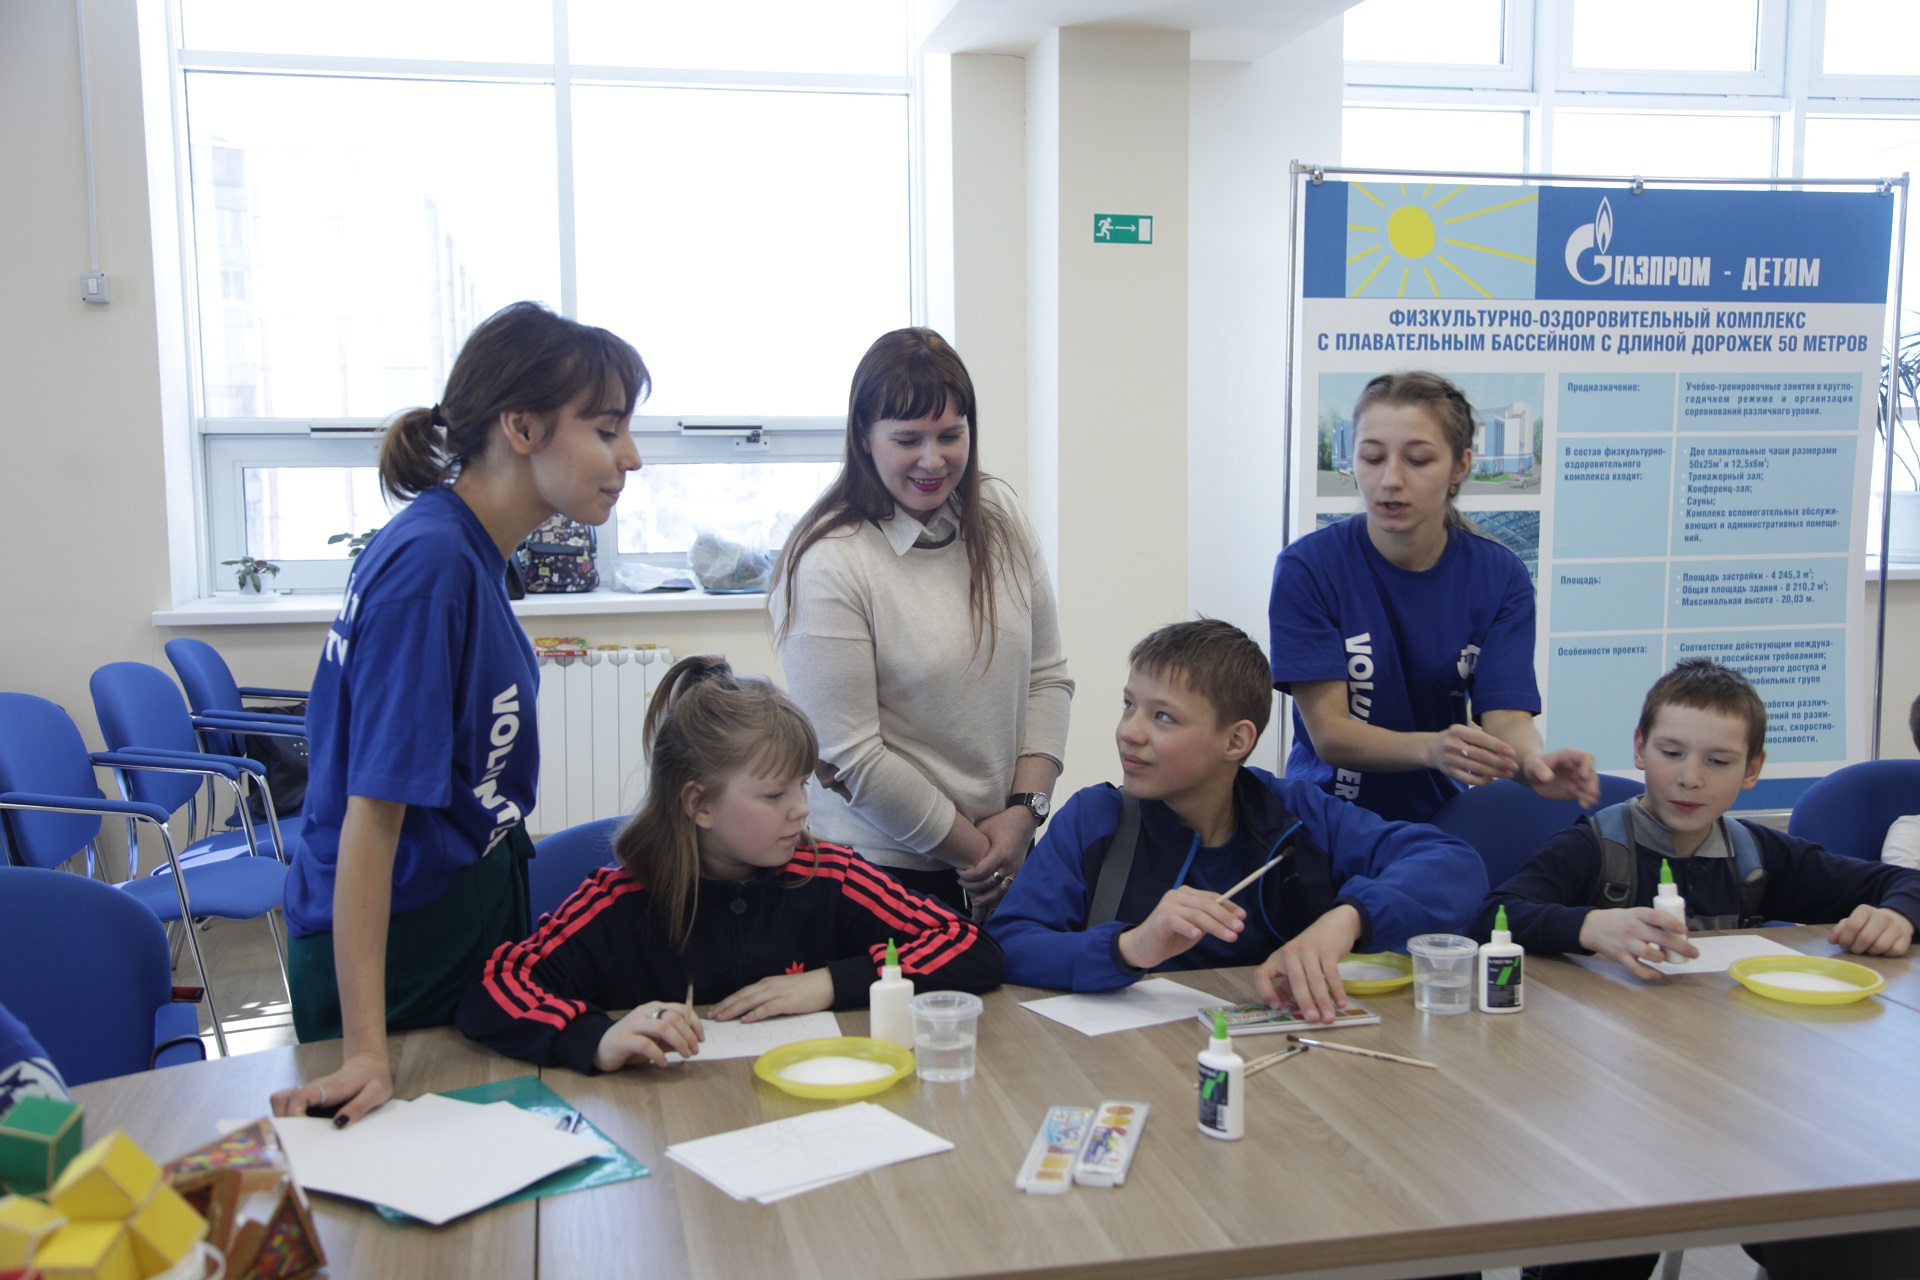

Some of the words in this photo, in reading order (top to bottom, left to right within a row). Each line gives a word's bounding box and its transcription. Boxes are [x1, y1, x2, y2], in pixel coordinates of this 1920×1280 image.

[1613, 255, 1711, 287] ГАЗПРОМ
[1741, 257, 1821, 291] ДЕТЯМ
[1389, 307, 1711, 331] ФИЗКУЛЬТУРНО-ОЗДОРОВИТЕЛЬНЫЙ
[1716, 311, 1806, 329] КОМПЛЕКС
[1317, 333, 1329, 351] С
[1335, 333, 1485, 351] ПЛАВАТЕЛЬНЫМ
[1491, 330, 1595, 351] БАССЕЙНОМ
[1601, 335, 1612, 351] С
[1617, 331, 1686, 355] ДЛИНОЙ
[1691, 334, 1773, 355] ДОРОЖЕК
[1778, 335, 1798, 351] 50
[1802, 335, 1869, 352] МЕТРОВ
[1567, 382, 1641, 393] Предназначение:
[1686, 382, 1781, 395] Учебно-тренировочные
[1782, 383, 1815, 391] занятия
[1816, 383, 1822, 391] в
[1823, 382, 1854, 393] кругло-
[1685, 395, 1730, 405] годичном
[1737, 395, 1774, 405] режиме
[1781, 395, 1787, 403] и
[1794, 395, 1853, 405] организация
[1684, 406, 1742, 417] соревнований
[1743, 407, 1790, 417] различного
[1792, 407, 1822, 417] уровня.
[1565, 447, 1571, 456] В
[1573, 448, 1602, 456] состав
[1604, 447, 1667, 457] физкультурно-
[1690, 447, 1705, 458] Две
[1707, 447, 1766, 456] плавательные
[1768, 447, 1790, 455] чаши
[1791, 447, 1837, 457] размерами
[1564, 460, 1642, 470] оздоровительного
[1564, 473, 1610, 481] комплекса
[1612, 472, 1643, 482] входят:
[1688, 471, 1744, 482] Тренажерный
[1746, 473, 1764, 482] зал;
[1687, 484, 1752, 494] Конференц-зал;
[1687, 497, 1716, 507] Сауны;
[1686, 509, 1726, 518] Комплекс
[1728, 508, 1799, 518] вспомогательных
[1801, 507, 1839, 518] обслужи-
[1685, 522, 1717, 531] вающих
[1727, 521, 1804, 531] административных
[1806, 519, 1840, 529] помеще-
[1684, 533, 1701, 542] ний.
[1560, 575, 1602, 586] Площадь:
[1682, 573, 1720, 583] Площадь
[1722, 571, 1764, 582] застройки
[1771, 571, 1776, 579] 4
[1778, 570, 1801, 580] 245,3
[1682, 585, 1709, 595] Общая
[1711, 585, 1747, 595] площадь
[1749, 584, 1778, 593] здания
[1785, 583, 1791, 591] 8
[1793, 582, 1815, 593] 210,2
[1681, 596, 1742, 607] Максимальная
[1744, 596, 1774, 605] высота
[1781, 595, 1804, 605] 20,03
[1806, 595, 1815, 603] м.
[1558, 646, 1611, 657] Особенности
[1612, 645, 1648, 656] проекта:
[1679, 642, 1733, 652] Соответствие
[1735, 640, 1792, 651] действующим
[1794, 639, 1833, 650] междуна-
[1721, 653, 1770, 664] российским
[1772, 651, 1827, 661] требованиям;
[1787, 663, 1819, 673] доступа
[1798, 675, 1821, 685] групп
[1797, 699, 1830, 709] различ-
[1334, 632, 1375, 800] VOLUER
[1804, 711, 1831, 721] разви-
[1790, 723, 1836, 733] скоростно-
